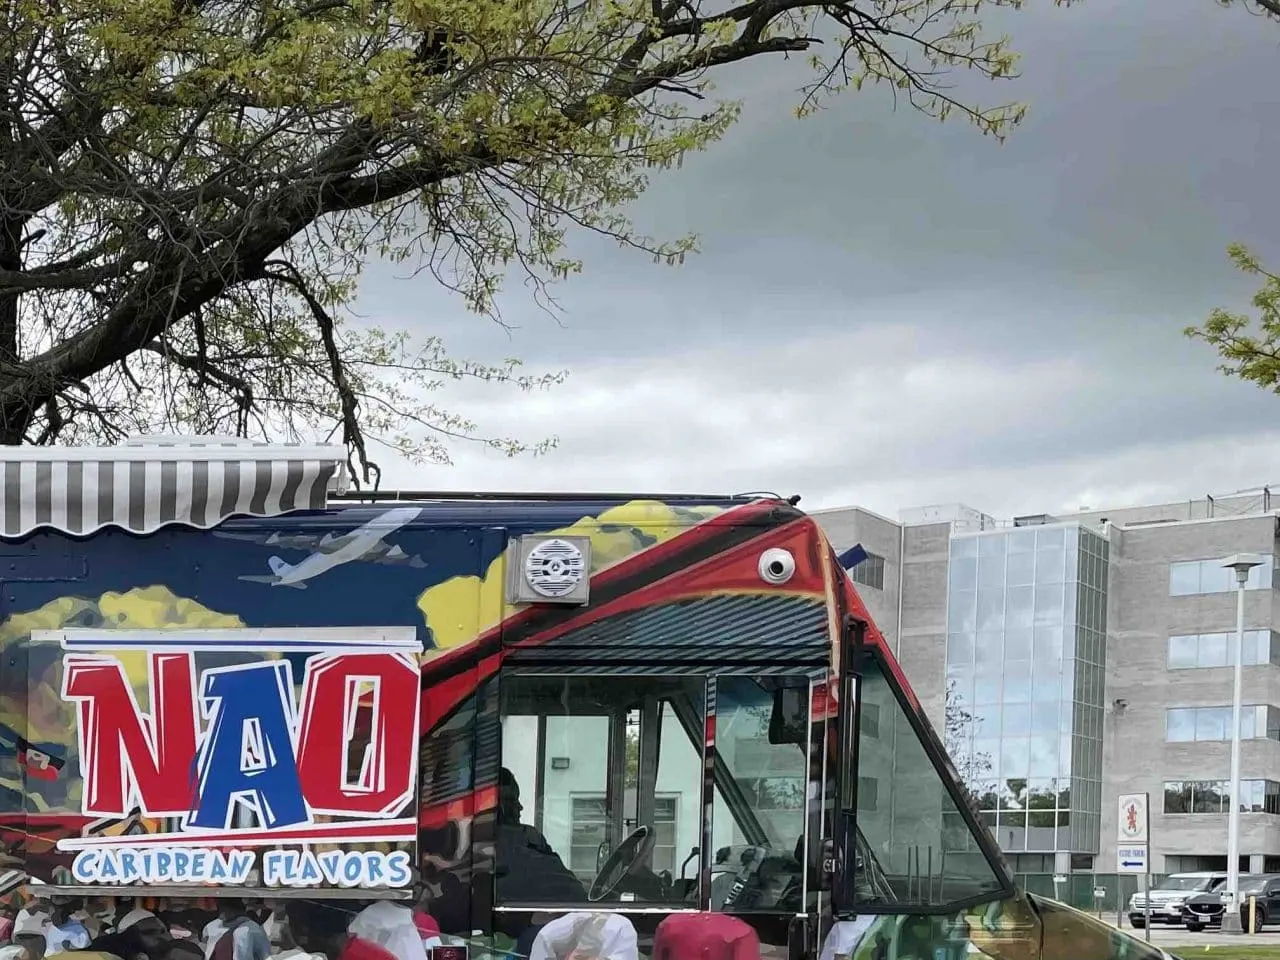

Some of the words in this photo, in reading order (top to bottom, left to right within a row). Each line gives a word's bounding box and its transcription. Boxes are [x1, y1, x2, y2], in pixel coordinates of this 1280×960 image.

[62, 650, 420, 831] NAO
[74, 851, 253, 882] CARIBBEAN
[266, 853, 409, 884] FLAVORS
